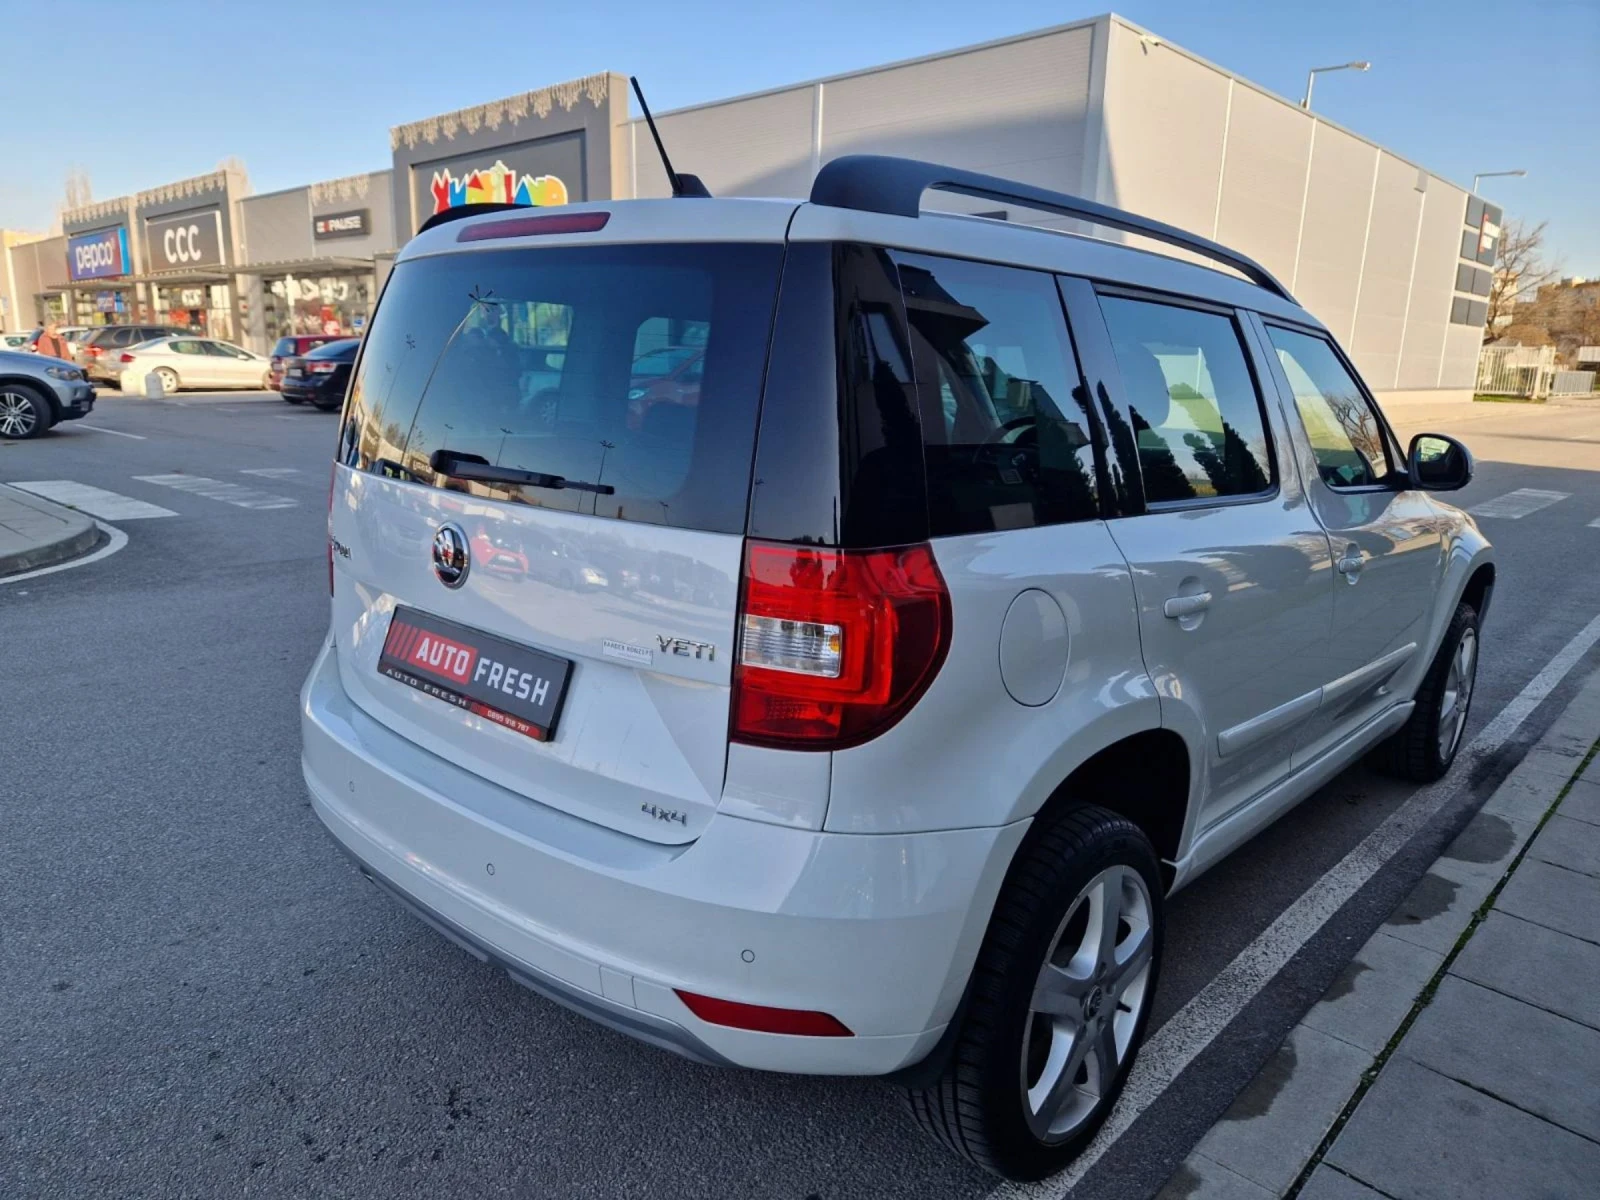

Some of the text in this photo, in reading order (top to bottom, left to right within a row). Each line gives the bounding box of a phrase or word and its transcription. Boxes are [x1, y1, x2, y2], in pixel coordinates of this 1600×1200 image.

[75, 240, 114, 275] pepco
[164, 225, 201, 263] CCC
[656, 634, 715, 661] YETI
[386, 668, 467, 707] AUTO FRESH
[416, 637, 550, 706] AUTO FRESH
